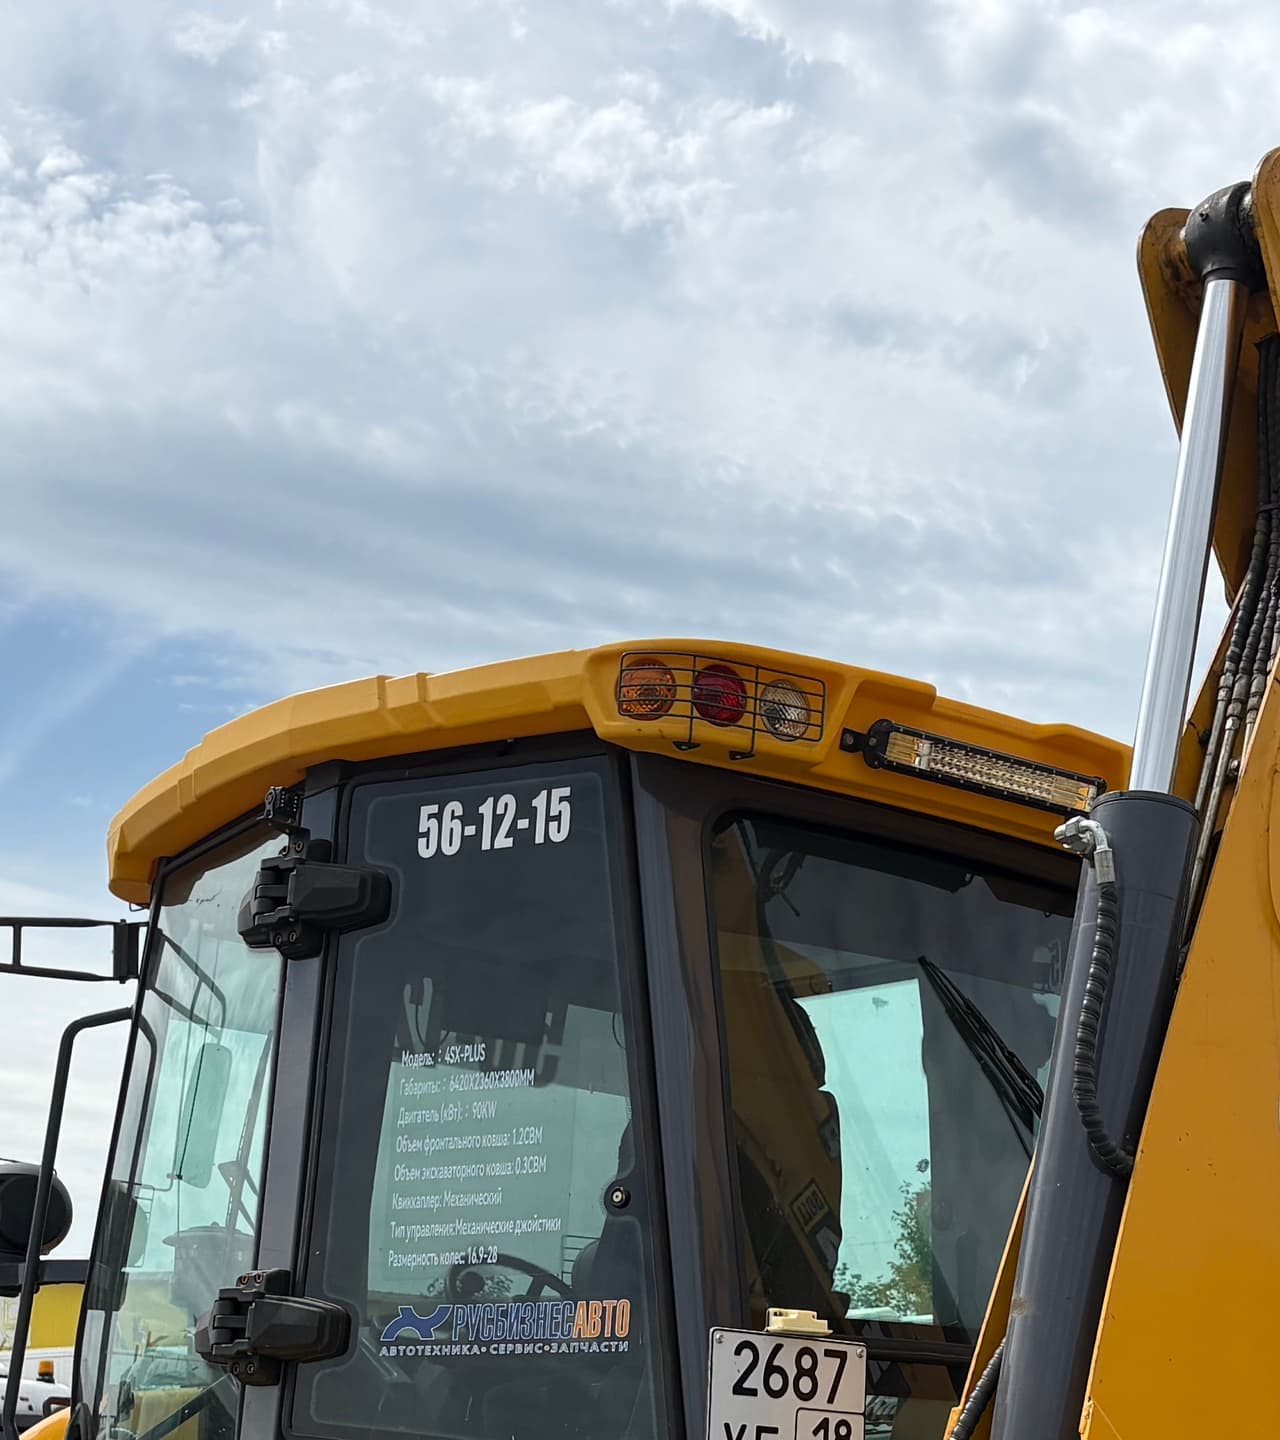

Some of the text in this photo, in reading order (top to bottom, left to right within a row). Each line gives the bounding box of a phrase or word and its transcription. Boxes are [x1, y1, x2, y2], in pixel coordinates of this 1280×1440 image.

[418, 787, 571, 859] 56-12-15
[444, 1043, 486, 1065] 4SX-PLUS
[397, 1107, 440, 1129] Двигатель
[396, 1135, 422, 1153] Объем
[423, 1134, 480, 1157] фронтального
[394, 1164, 420, 1182] Объем
[421, 1163, 485, 1183] экскаваторного
[443, 1186, 502, 1207] Механический
[390, 1221, 406, 1239] Тип
[514, 1214, 561, 1236] джойстики
[388, 1250, 439, 1270] Размерность
[467, 1246, 498, 1264] 16.9-28
[451, 1299, 631, 1341] РУСБИЗНЕСАВТО
[732, 1340, 848, 1404] 2687
